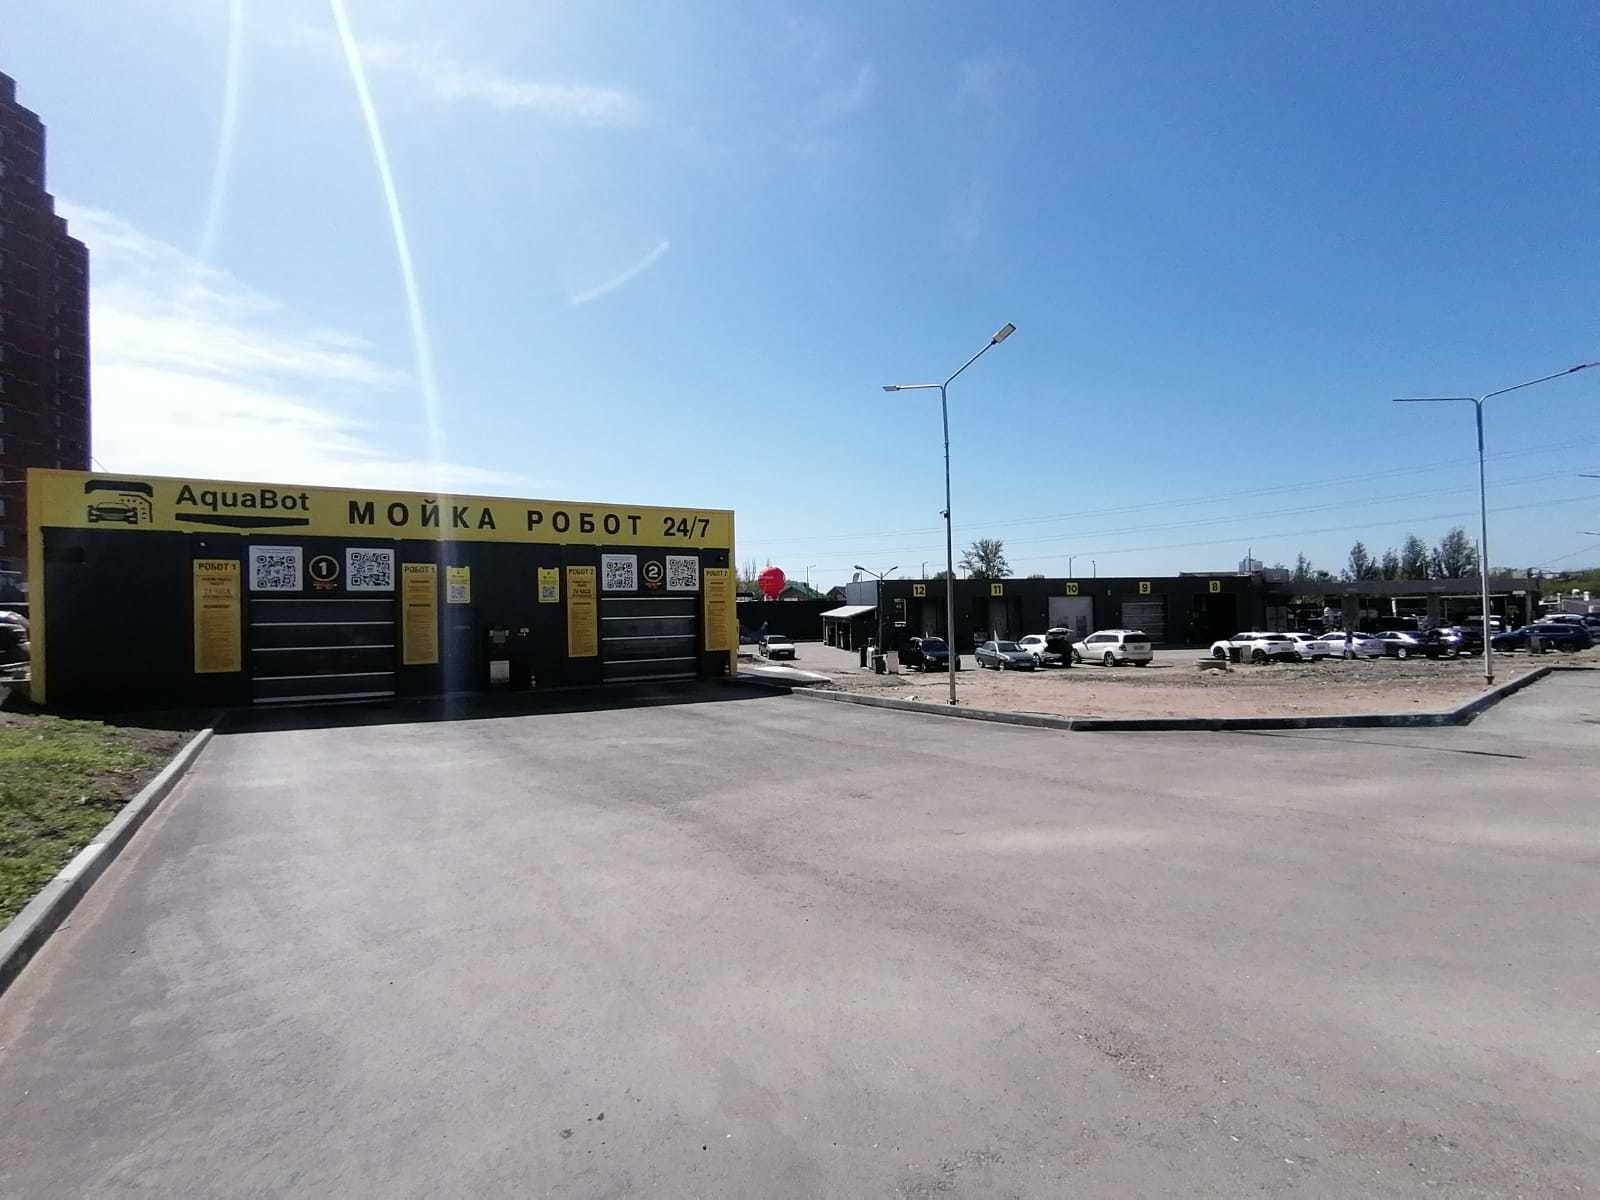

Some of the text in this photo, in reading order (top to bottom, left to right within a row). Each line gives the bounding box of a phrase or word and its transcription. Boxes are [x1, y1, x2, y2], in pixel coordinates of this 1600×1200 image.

[176, 485, 310, 512] AquaBot
[348, 499, 710, 539] МОЙКА РОБОТ 24/7
[318, 561, 327, 576] 1
[648, 565, 659, 577] 2
